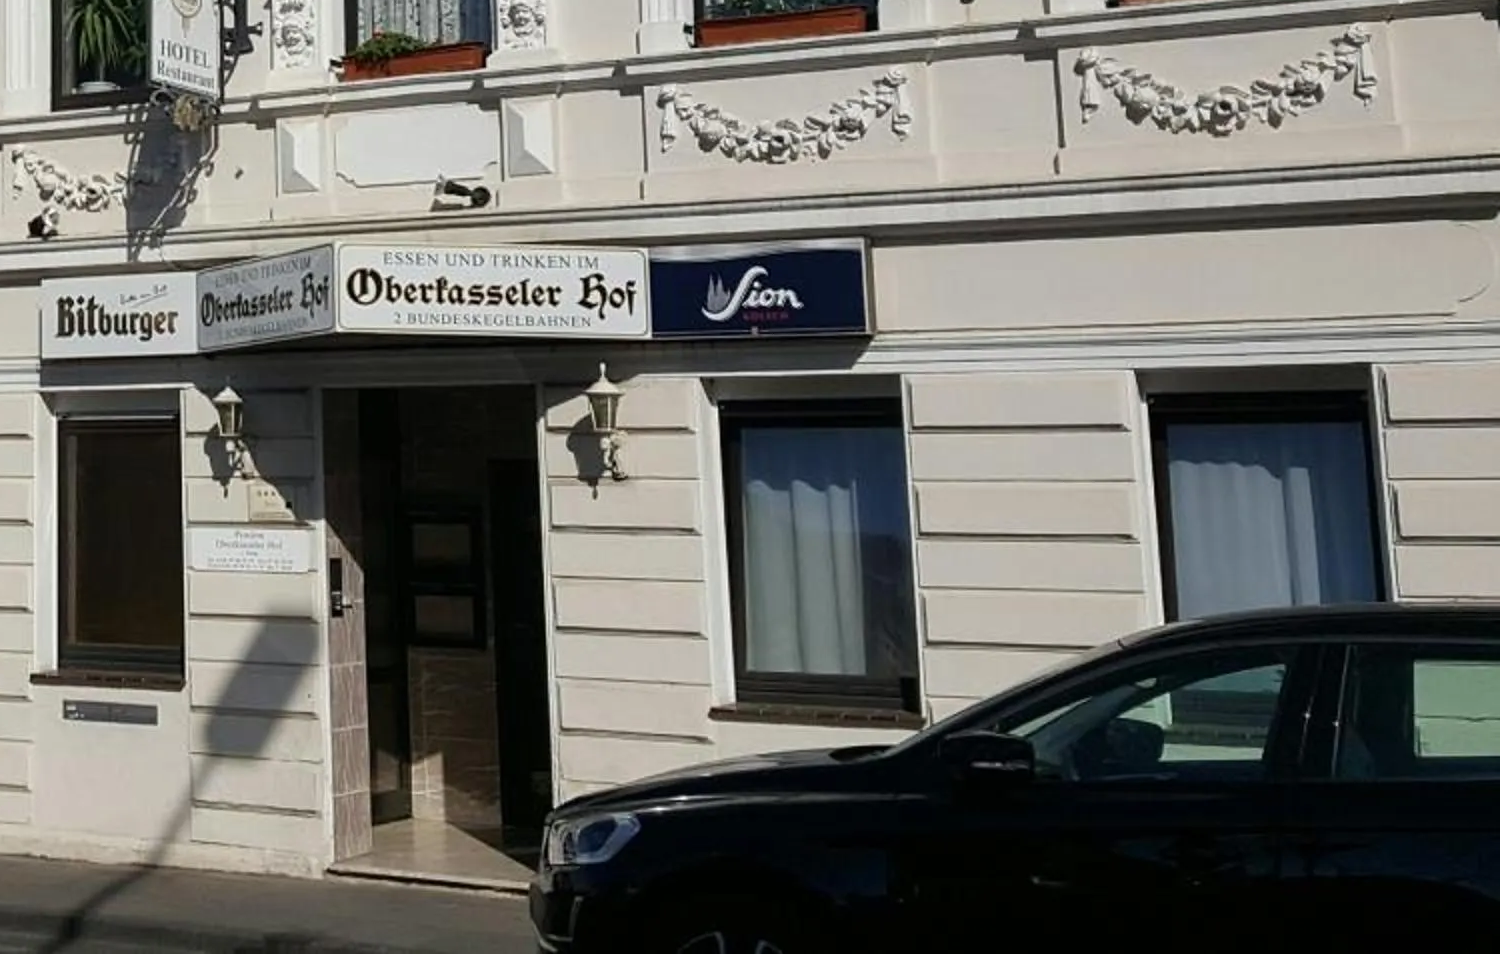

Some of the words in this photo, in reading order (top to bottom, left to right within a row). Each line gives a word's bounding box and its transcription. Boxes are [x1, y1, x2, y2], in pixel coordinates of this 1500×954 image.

[160, 38, 211, 68] HOTEL
[156, 59, 215, 89] Restaurant
[383, 252, 439, 266] ESSEN
[445, 253, 485, 267] UND
[490, 253, 571, 268] TRINKEN
[577, 256, 599, 269] IM
[201, 285, 294, 327] Oberkasseler
[300, 272, 329, 319] Hof
[347, 267, 563, 306] Oberkasseler
[577, 273, 637, 320] Hof
[701, 265, 804, 321] Sion
[56, 296, 179, 341] Bitburger
[394, 312, 402, 324] 2
[406, 312, 592, 327] BUNDESKEGELBAHNEN
